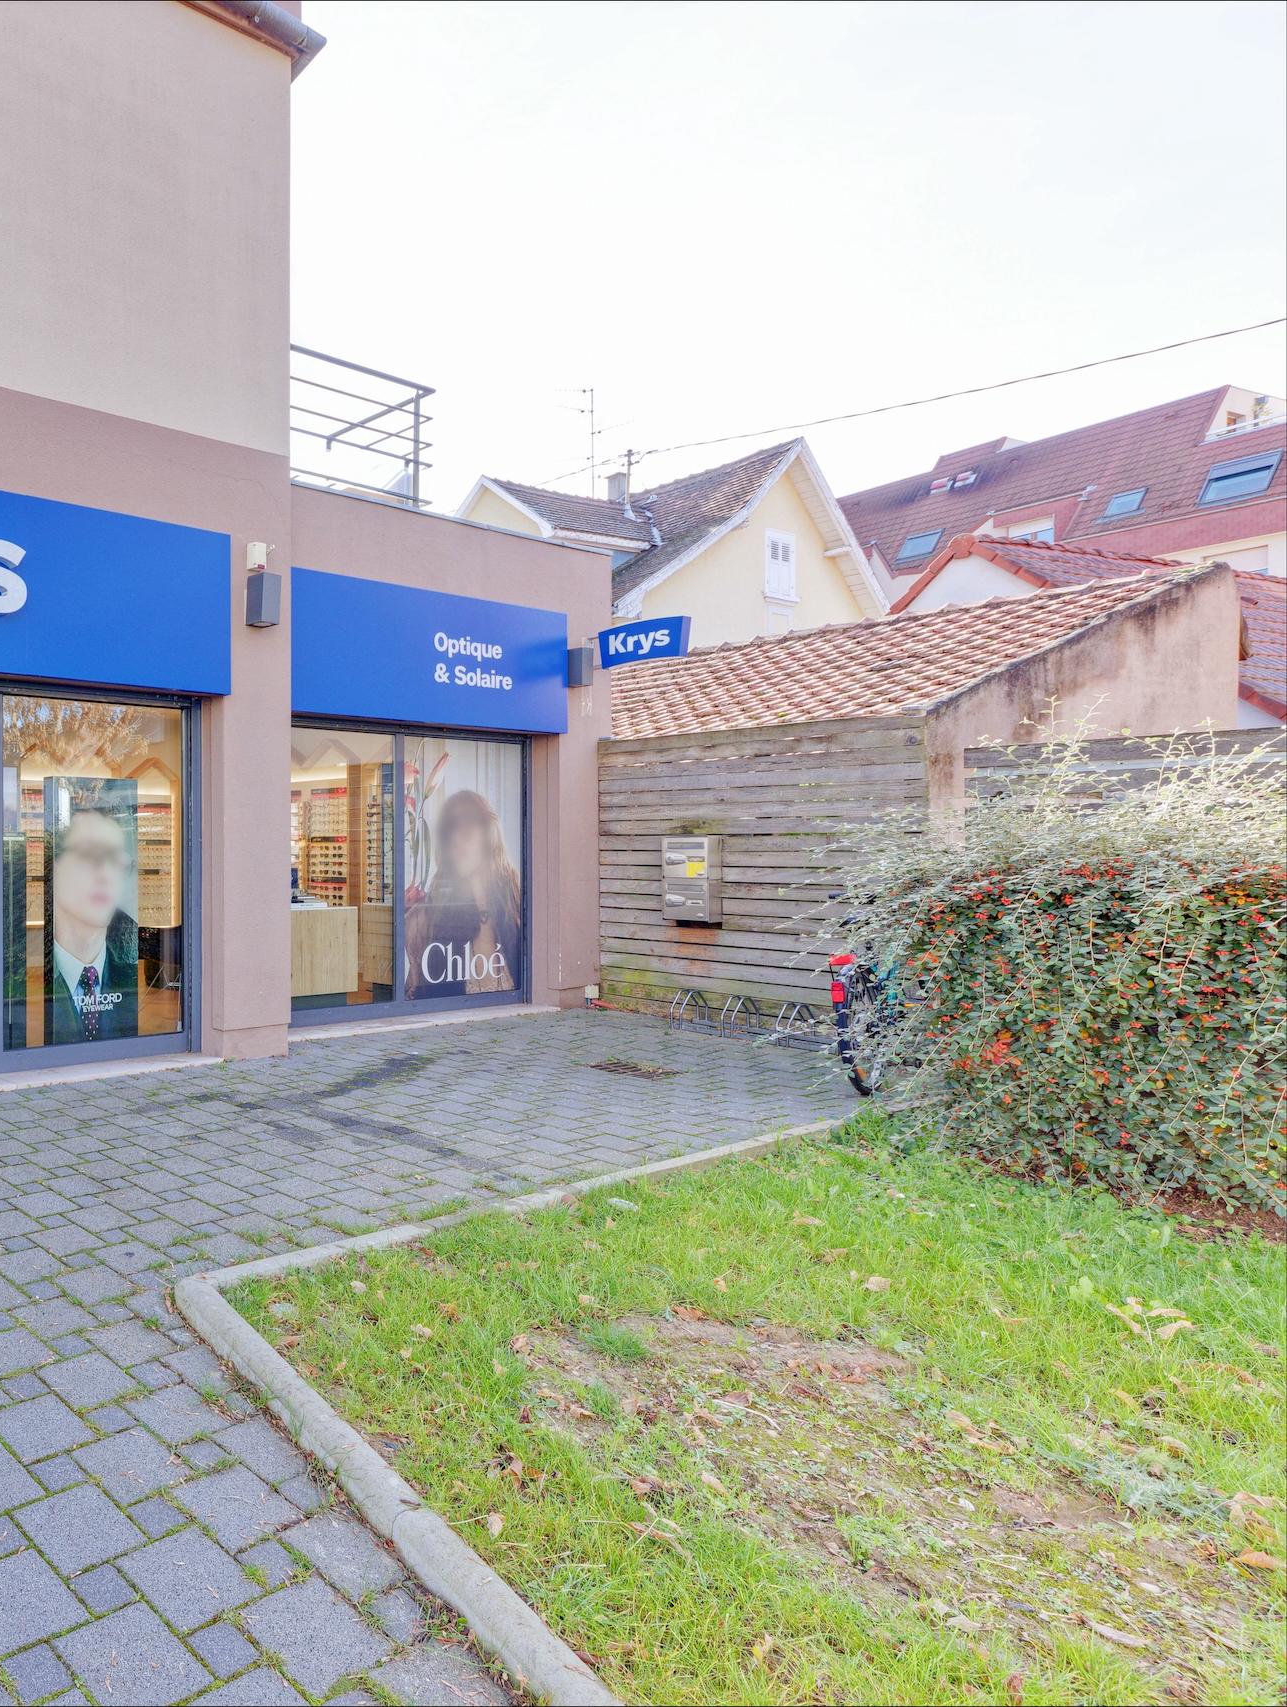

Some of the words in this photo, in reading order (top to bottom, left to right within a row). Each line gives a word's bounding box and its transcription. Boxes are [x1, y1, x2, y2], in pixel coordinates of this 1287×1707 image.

[433, 632, 503, 661] Optique
[608, 629, 670, 656] Krys
[434, 663, 450, 683] &
[454, 664, 513, 690] Solaire
[421, 940, 505, 984] Chloé
[73, 994, 95, 1006] TOM
[96, 993, 123, 1004] FORD
[82, 1004, 114, 1013] EYEWEAR
